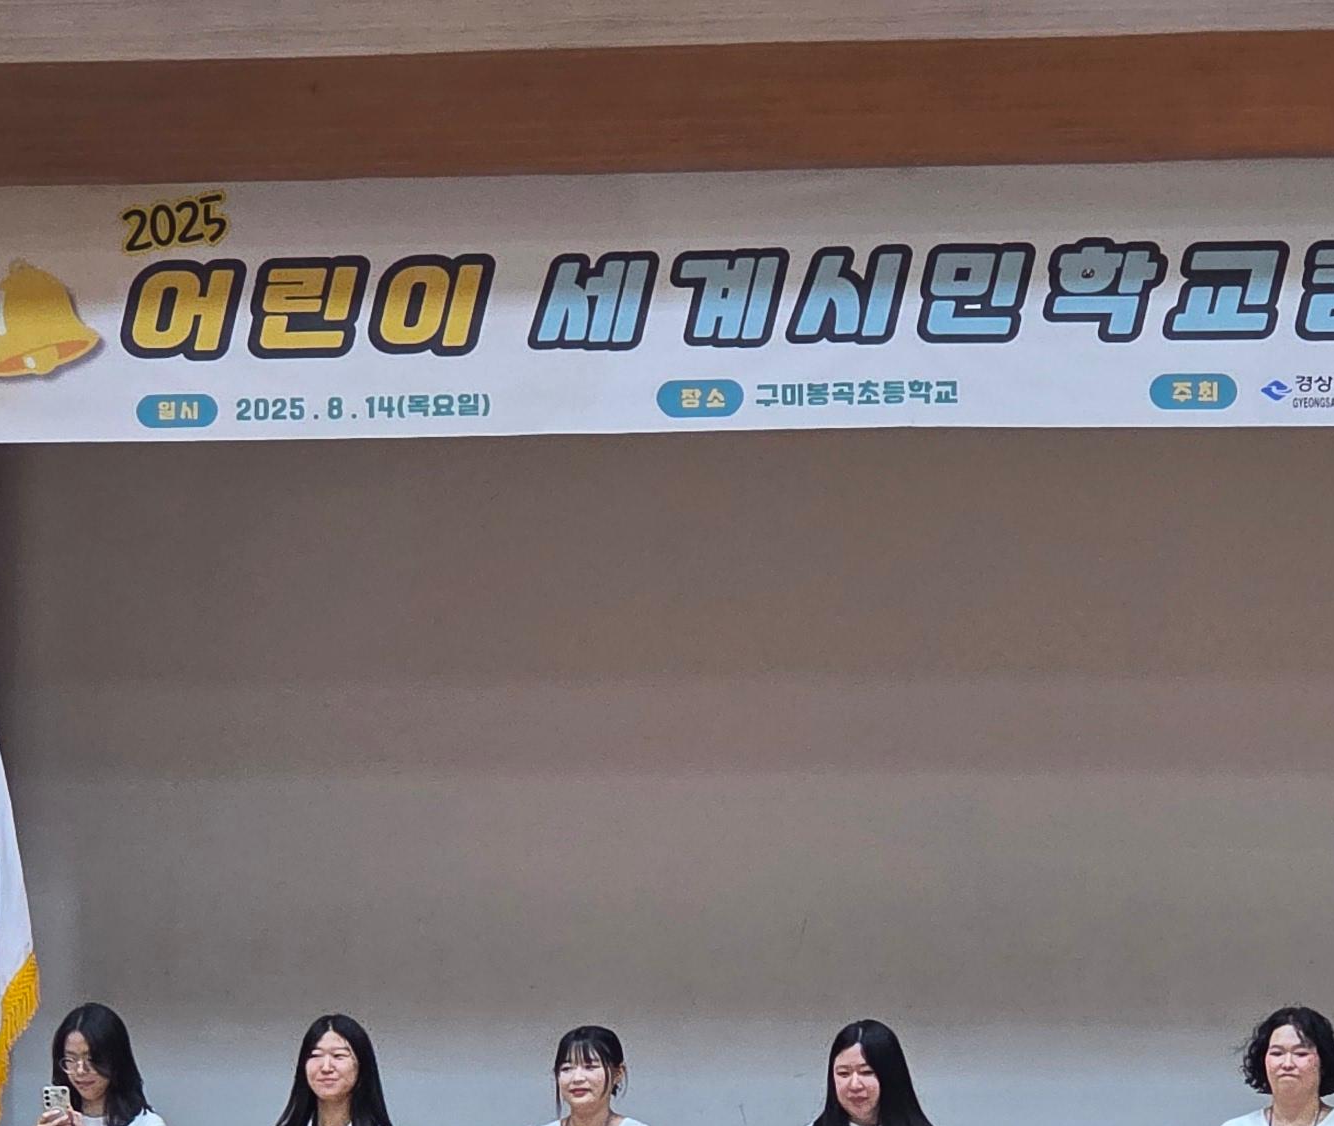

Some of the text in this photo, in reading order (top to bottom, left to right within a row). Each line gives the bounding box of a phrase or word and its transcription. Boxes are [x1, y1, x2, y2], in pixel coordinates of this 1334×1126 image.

[124, 193, 228, 253] 2025
[121, 254, 496, 361] 어린이
[157, 400, 199, 421] 일시
[680, 379, 959, 409] 장소 구미봉곡초등학교
